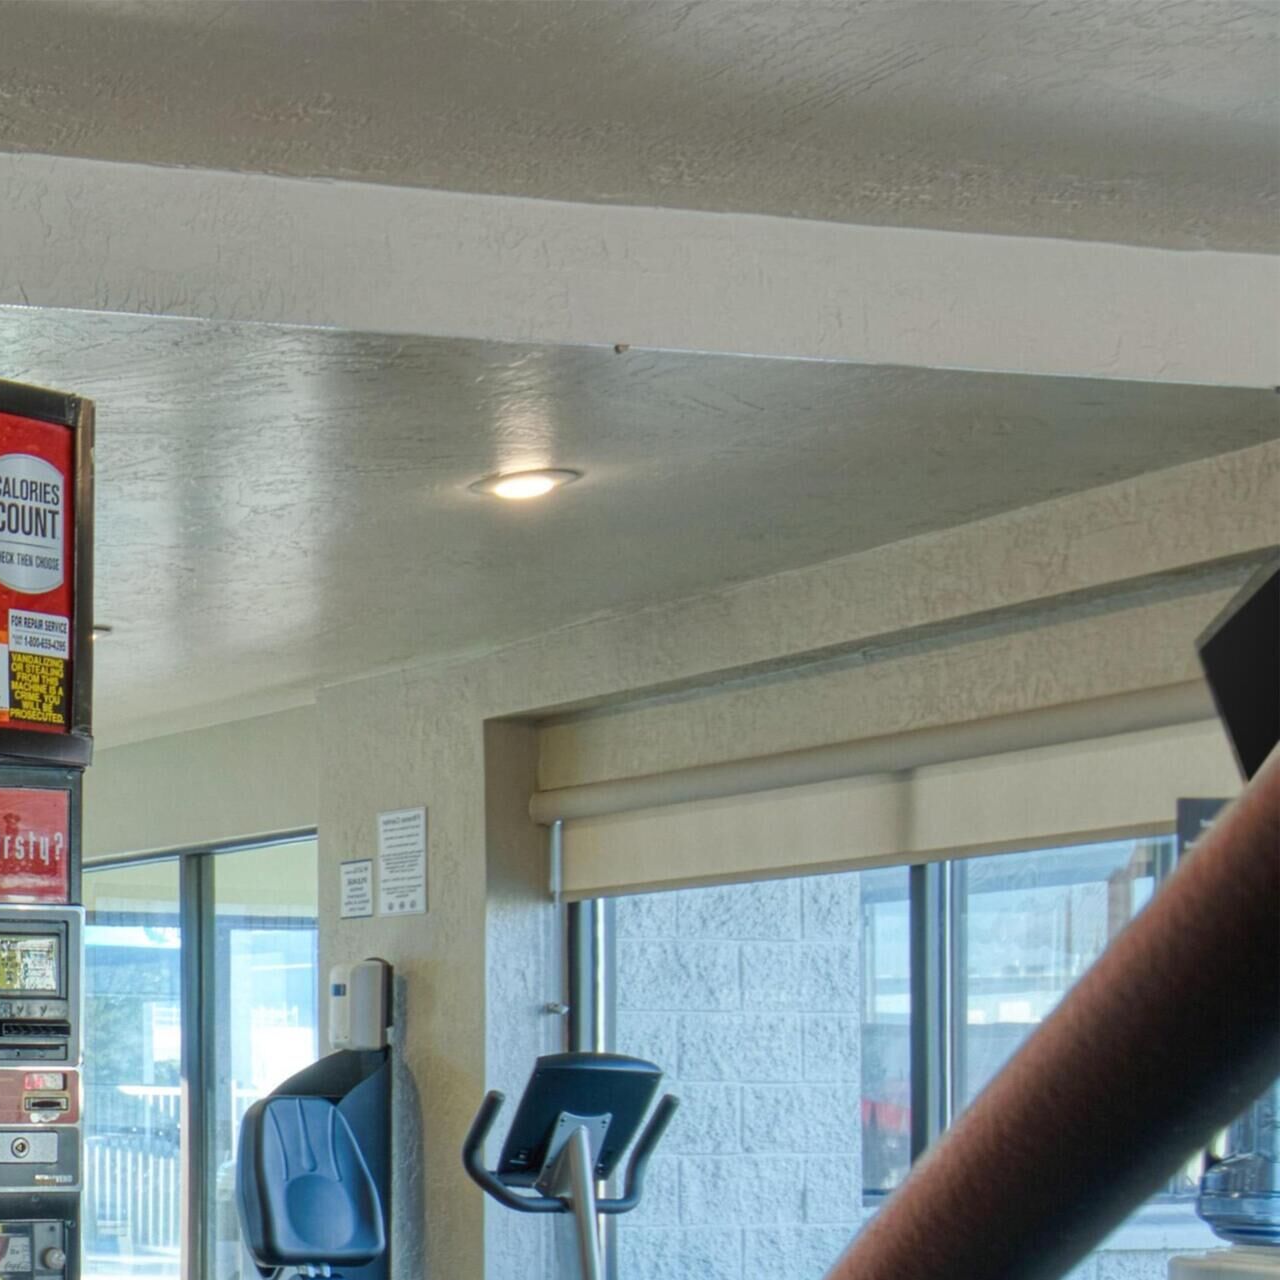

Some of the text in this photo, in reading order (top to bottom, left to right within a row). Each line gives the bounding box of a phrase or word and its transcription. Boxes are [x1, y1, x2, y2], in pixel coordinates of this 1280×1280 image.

[16, 553, 34, 568] THEN
[38, 555, 60, 572] CHOOSE
[11, 615, 67, 634] FOR REPAIR SERVICE
[11, 653, 64, 669] VANDALIZING
[11, 663, 64, 679] OR STEALING
[16, 672, 59, 686] FROM THIS
[11, 681, 64, 697] MACHINE IS A
[21, 700, 53, 712] WILL BE
[44, 695, 61, 706] YOU
